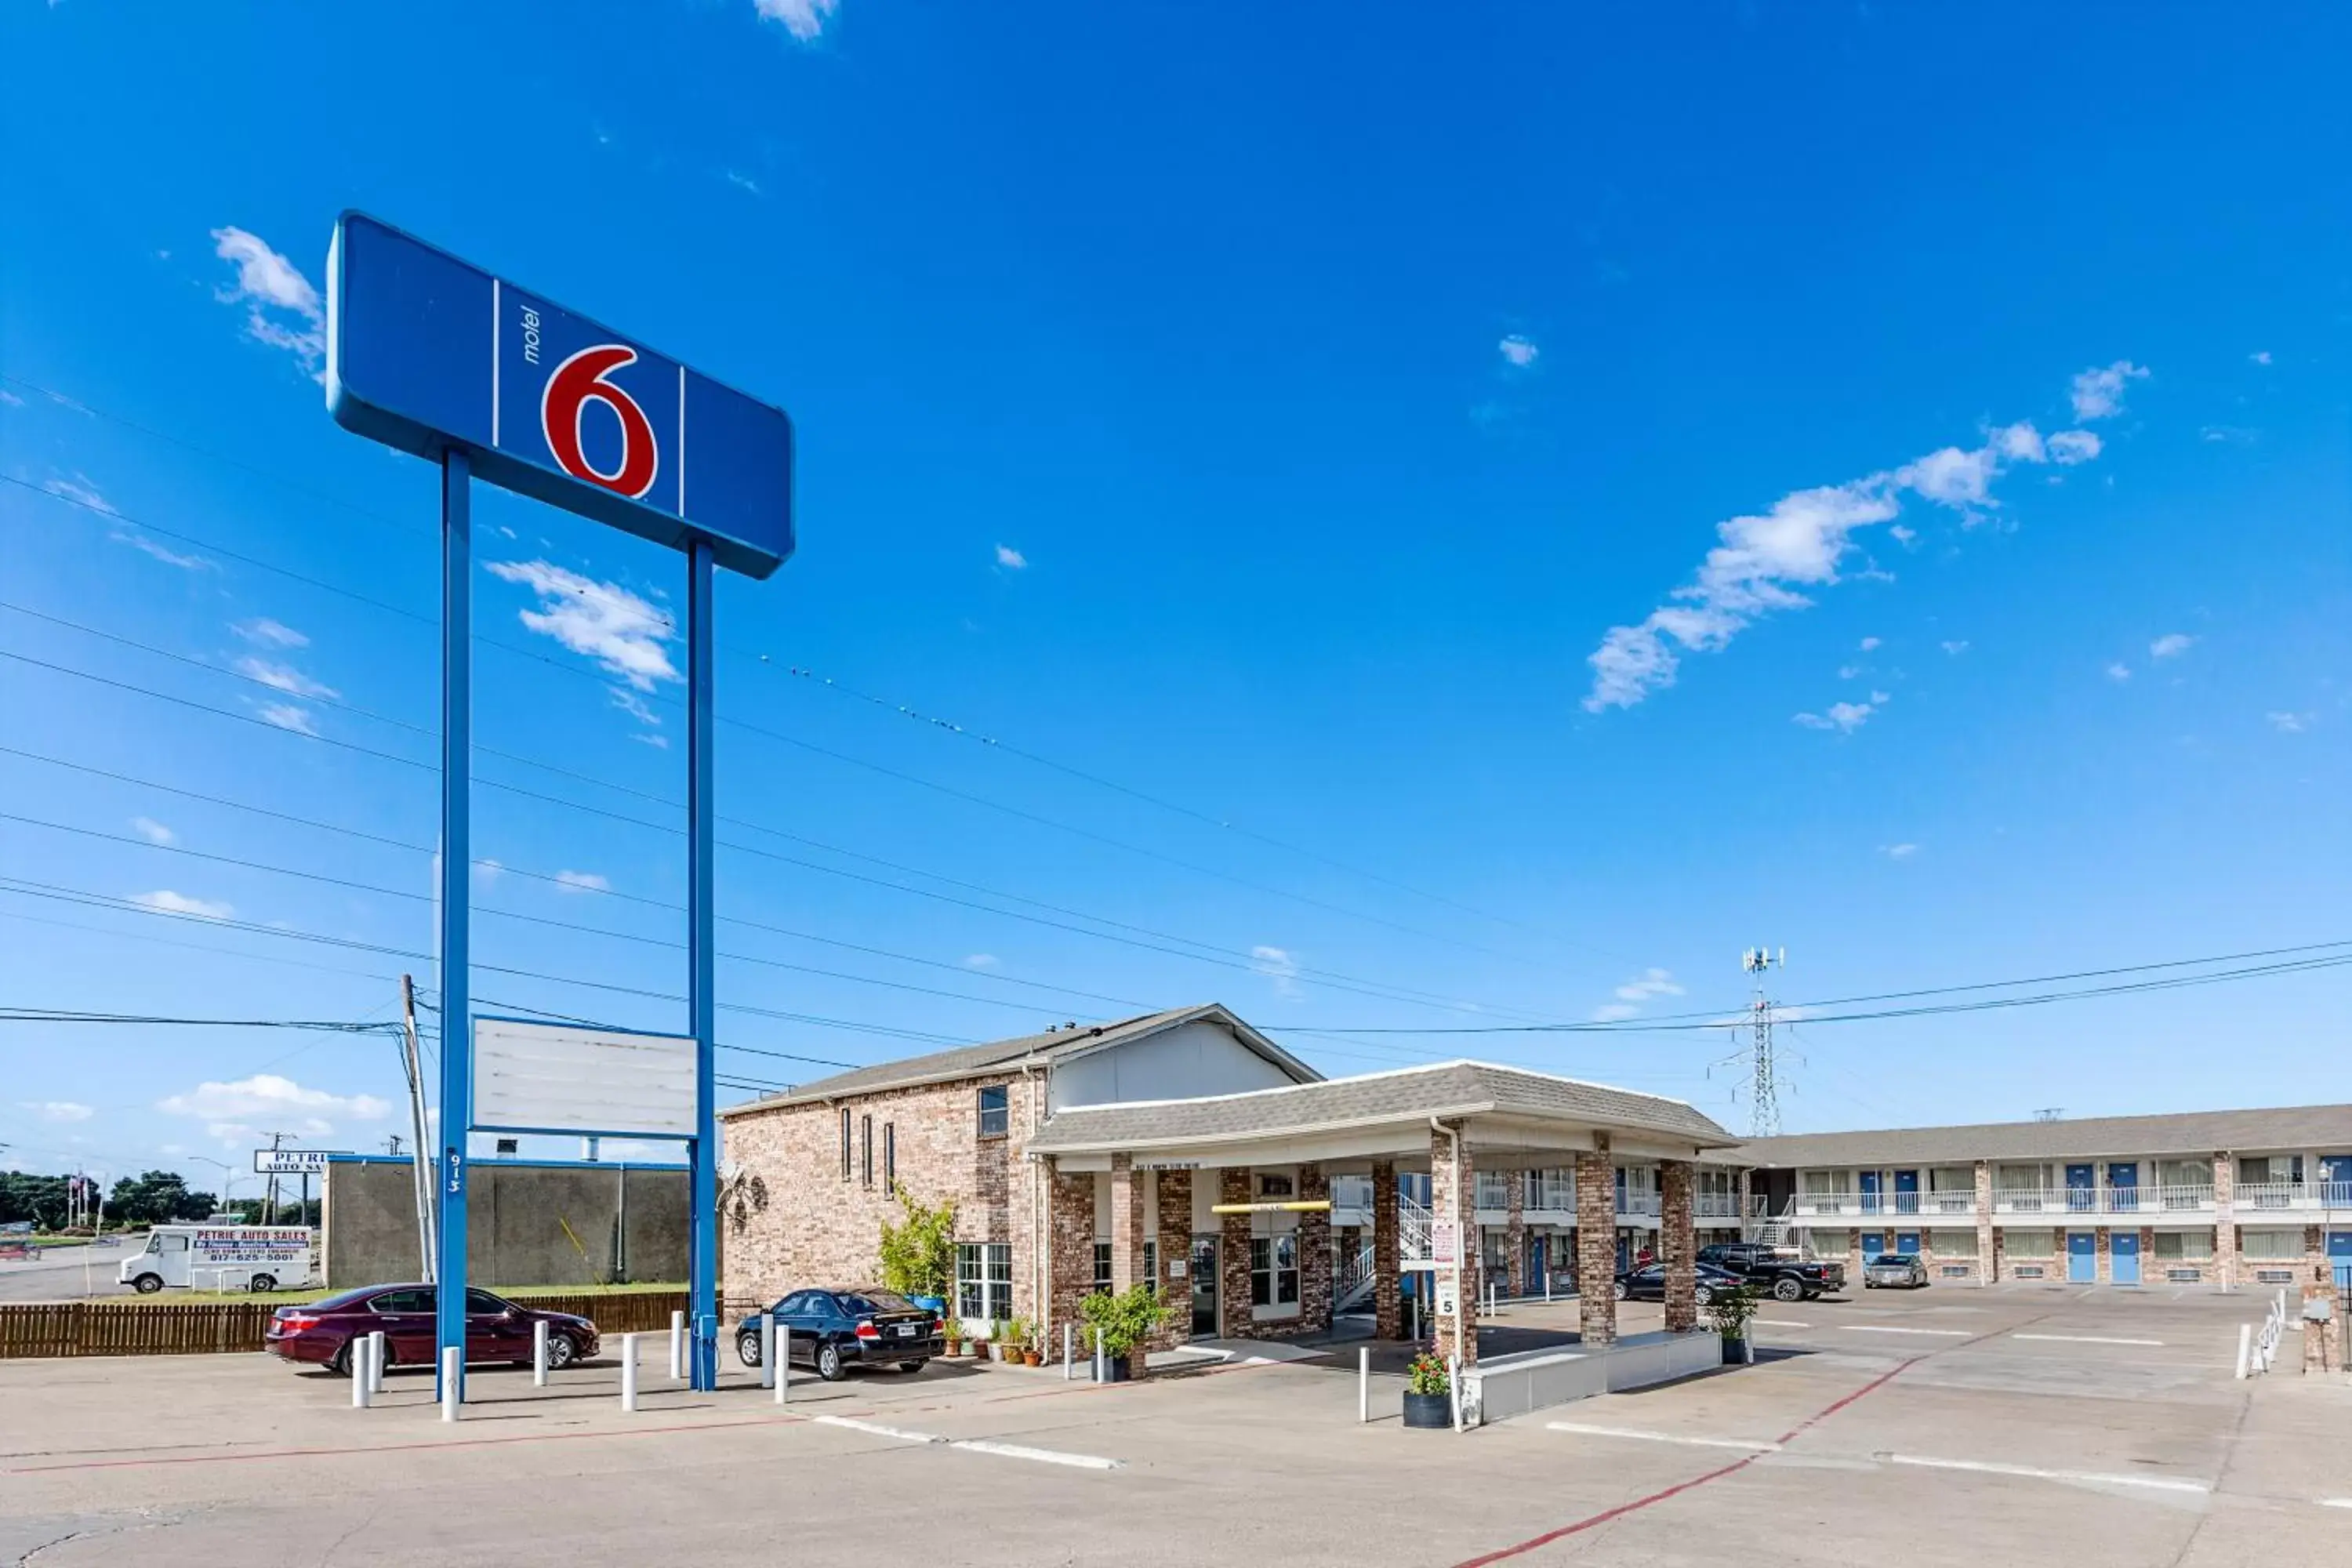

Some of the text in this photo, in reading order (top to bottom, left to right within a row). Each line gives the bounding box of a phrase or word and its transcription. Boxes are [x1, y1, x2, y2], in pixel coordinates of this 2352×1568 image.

[520, 304, 540, 365] motel
[540, 344, 659, 499] 6
[275, 1153, 325, 1162] PETRI
[197, 1230, 307, 1240] PETRIE AUTO SALES
[1444, 1301, 1453, 1313] 5
